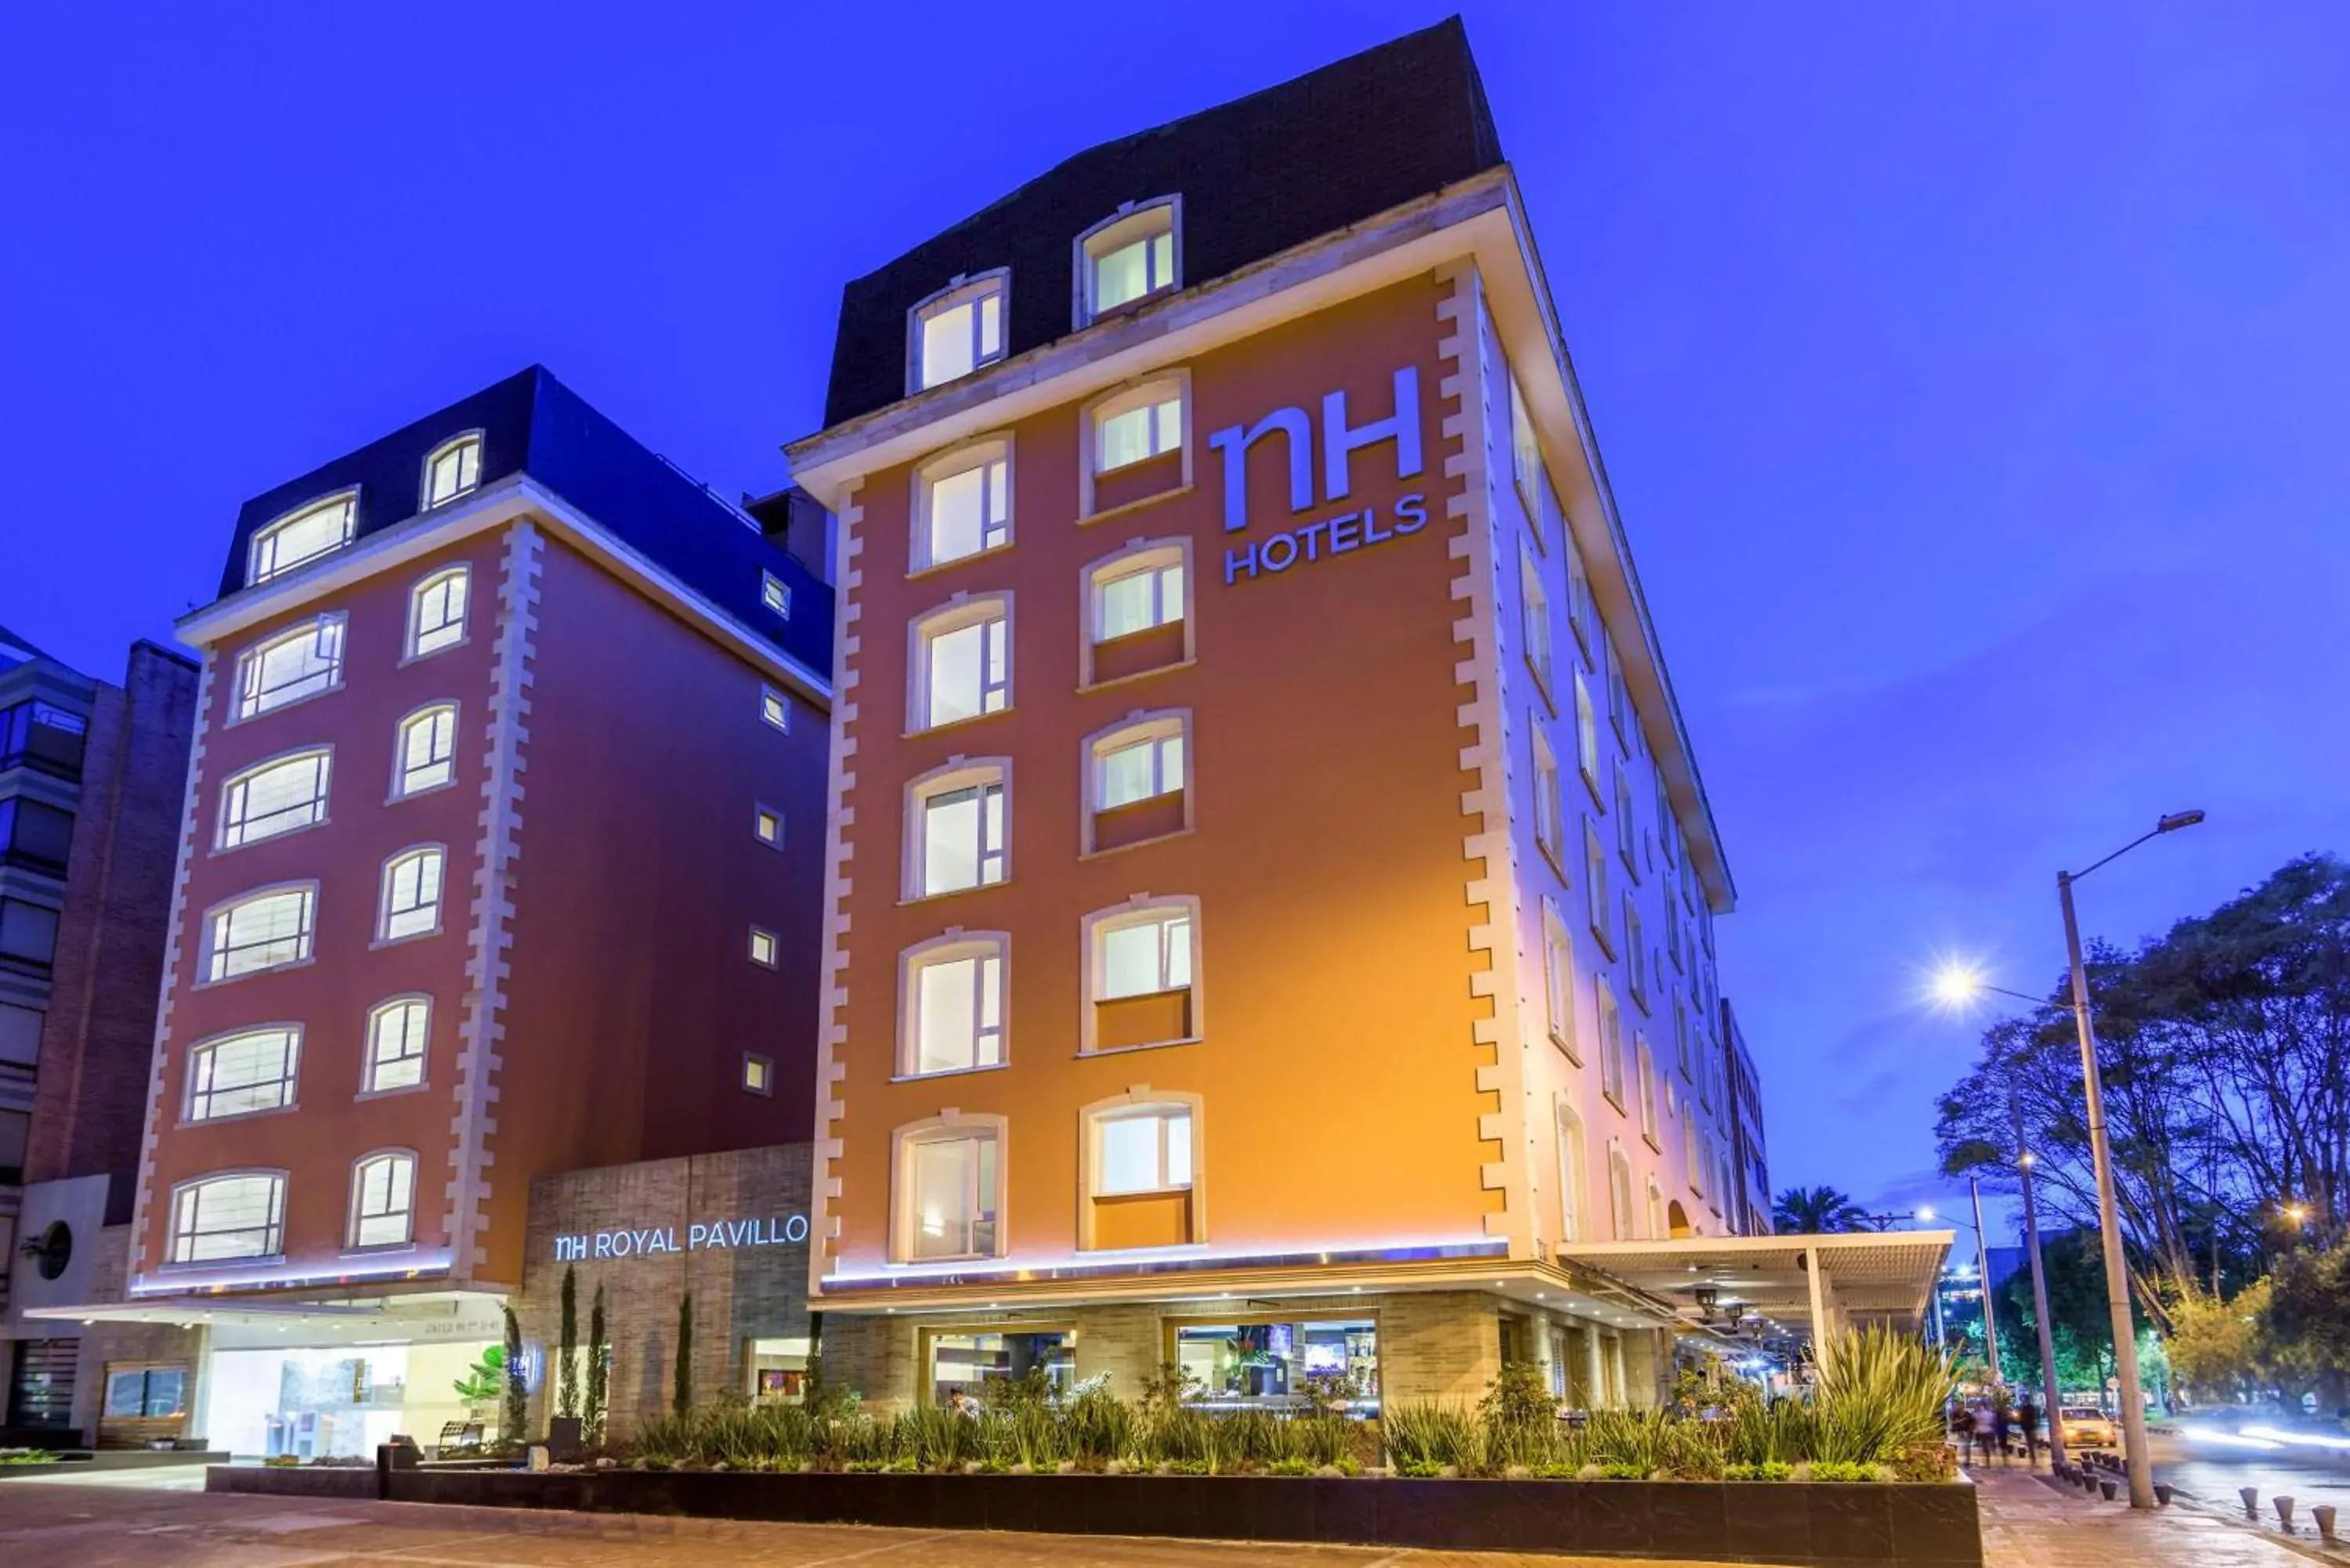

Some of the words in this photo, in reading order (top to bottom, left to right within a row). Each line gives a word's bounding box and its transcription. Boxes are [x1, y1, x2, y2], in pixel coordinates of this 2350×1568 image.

[1224, 493, 1426, 584] HOTELS
[595, 1227, 682, 1258] ROYAL
[689, 1215, 808, 1251] PAVILLO
